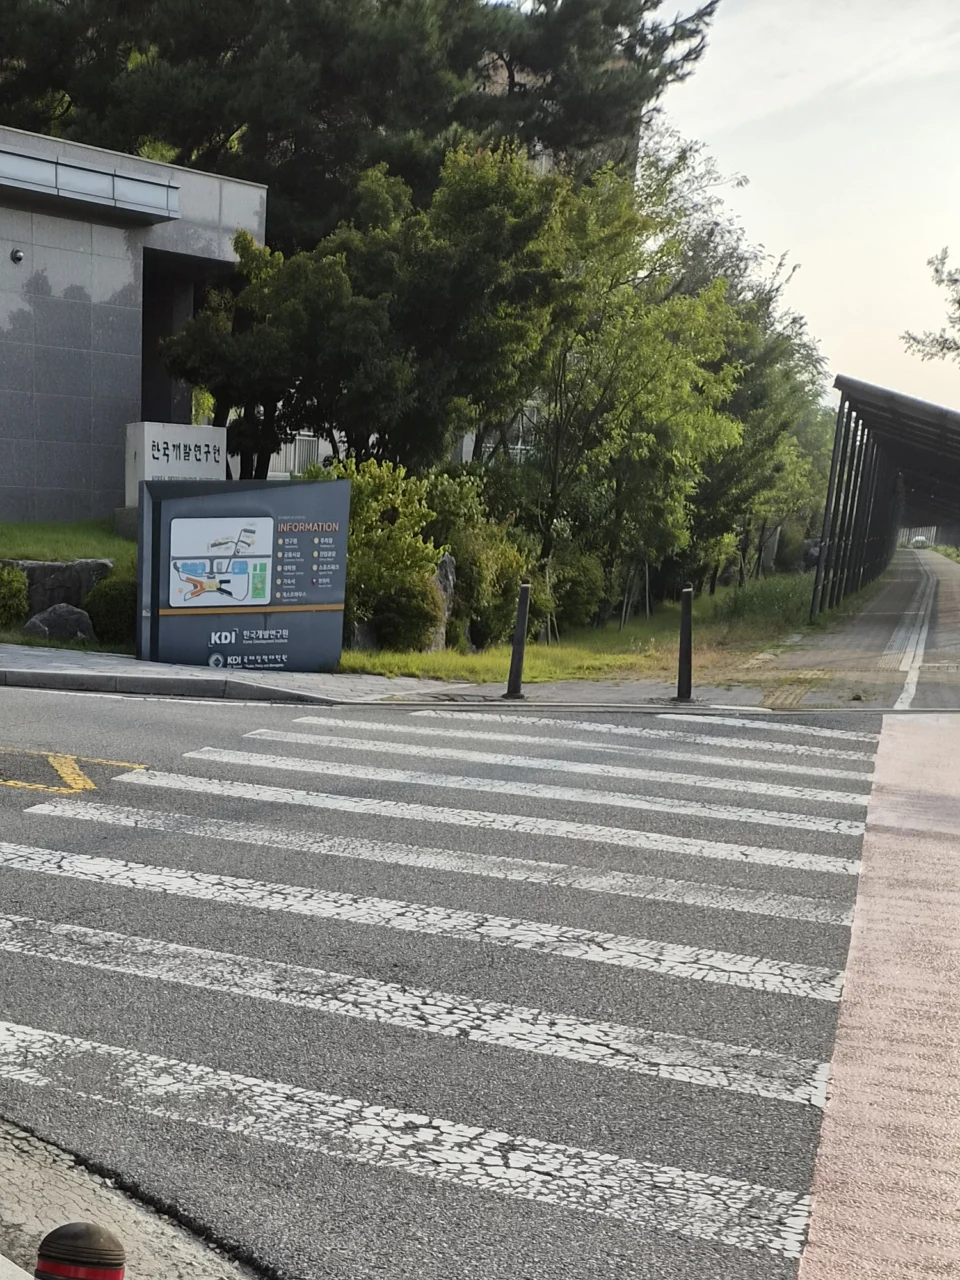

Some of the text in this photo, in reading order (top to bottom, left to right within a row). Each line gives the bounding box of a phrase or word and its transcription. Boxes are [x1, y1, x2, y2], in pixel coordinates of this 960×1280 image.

[151, 440, 220, 463] 한국개발연구원
[277, 522, 339, 532] INFORMATION
[211, 631, 236, 644] KDI
[243, 629, 289, 639] 한국개발연구원
[227, 655, 241, 664] KDI
